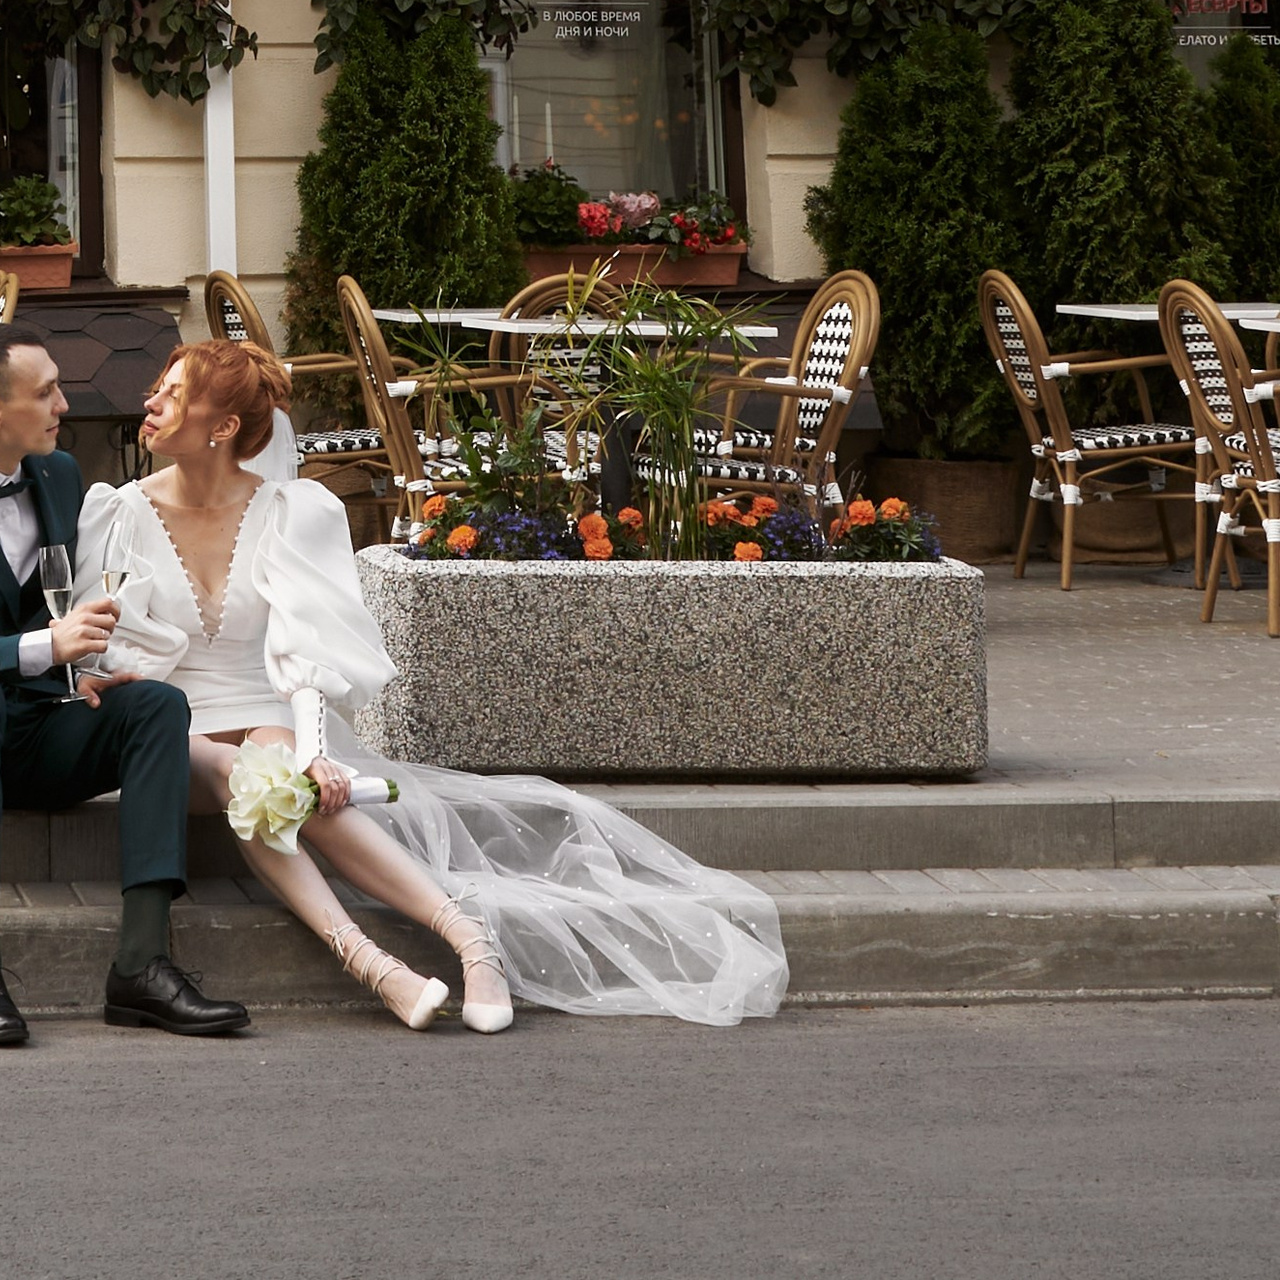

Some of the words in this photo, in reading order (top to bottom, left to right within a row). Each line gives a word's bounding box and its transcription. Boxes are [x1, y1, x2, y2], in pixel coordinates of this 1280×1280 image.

[543, 11, 551, 22] В
[553, 11, 598, 22] ЛЮБОЕ
[601, 11, 641, 22] ВРЕМЯ
[555, 26, 581, 39] ДНЯ
[583, 26, 592, 37] И
[595, 26, 630, 38] НОЧИ
